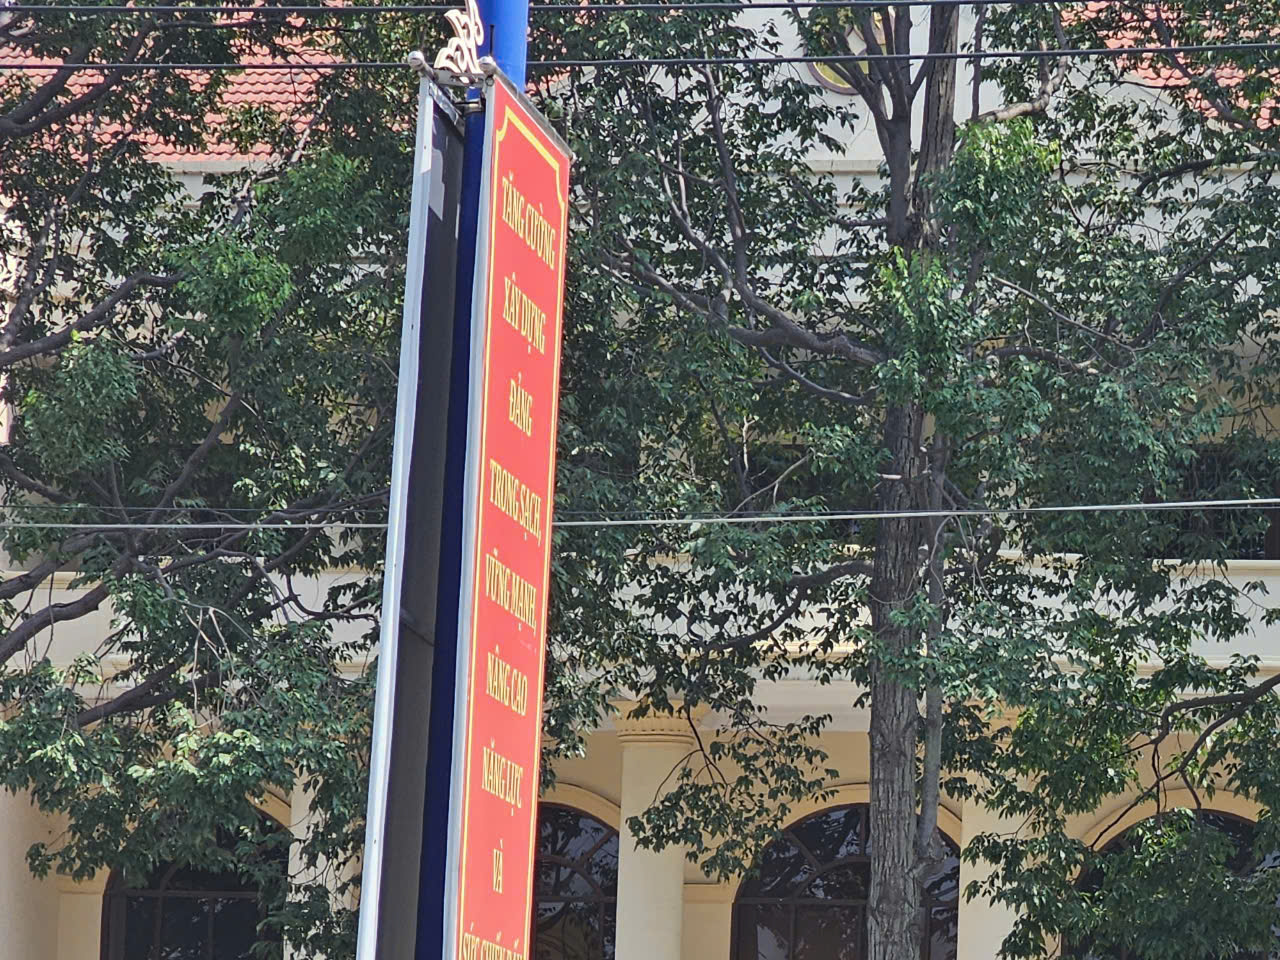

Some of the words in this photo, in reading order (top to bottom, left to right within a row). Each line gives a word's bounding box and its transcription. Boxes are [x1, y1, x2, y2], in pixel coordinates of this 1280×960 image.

[502, 170, 525, 239] TĂNG
[525, 202, 556, 270] CƯỜNG
[503, 272, 522, 331] XÂY
[521, 293, 546, 355] DỰNG
[508, 371, 533, 437] ĐẢNG
[489, 458, 520, 522] TRONG
[519, 484, 542, 547] SẠCH,
[485, 547, 511, 612] VỮNG
[510, 571, 537, 636] MẠNH,
[486, 644, 511, 706] NÂNG
[511, 668, 528, 716] CAO
[482, 737, 506, 800] NĂNG
[505, 760, 524, 817] LỰC
[493, 838, 504, 894] VÀ
